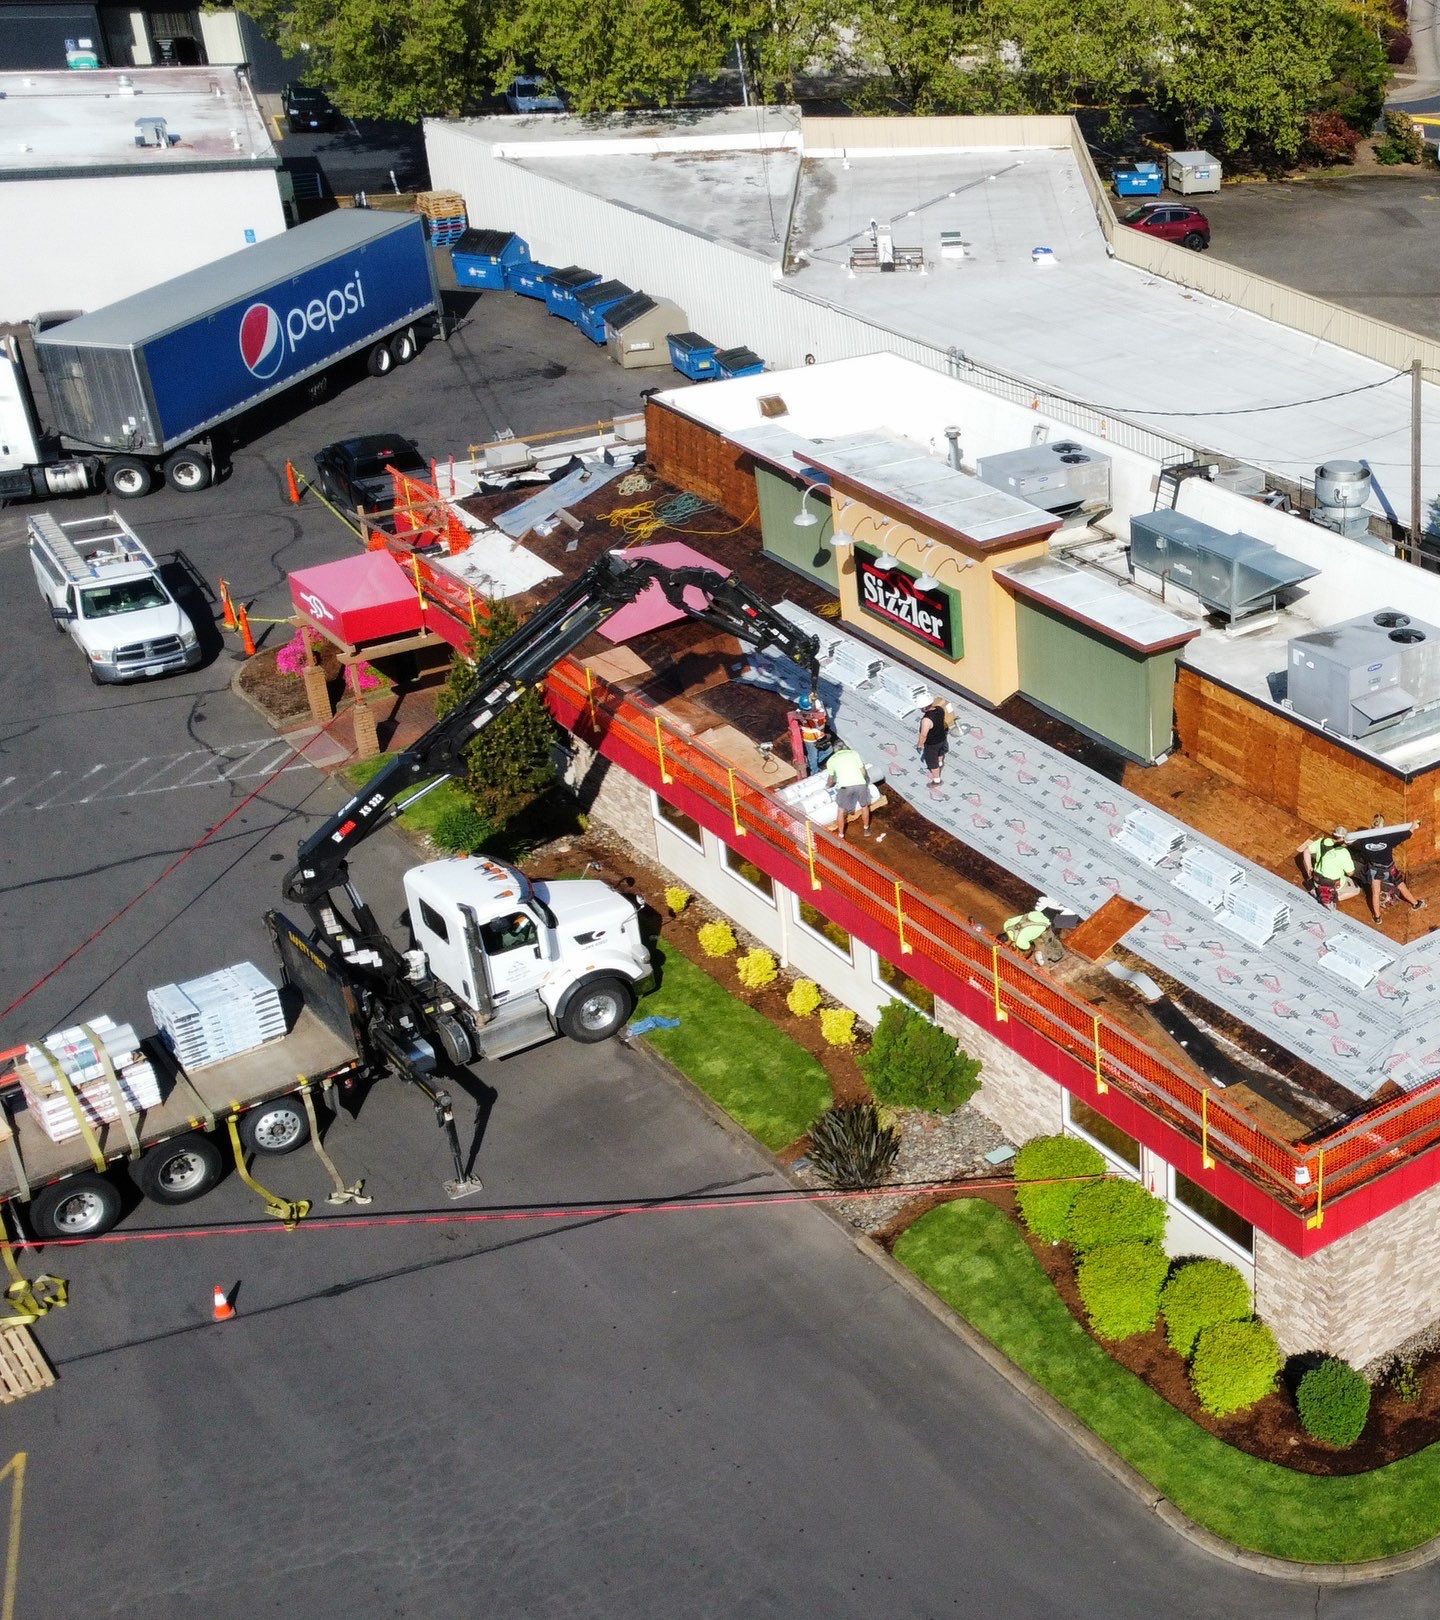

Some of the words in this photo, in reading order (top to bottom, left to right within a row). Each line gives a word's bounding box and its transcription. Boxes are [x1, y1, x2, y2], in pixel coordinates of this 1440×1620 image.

[287, 270, 366, 353] pepsi
[862, 571, 944, 640] Sizzler
[358, 805, 372, 817] XS
[368, 794, 385, 808] 322
